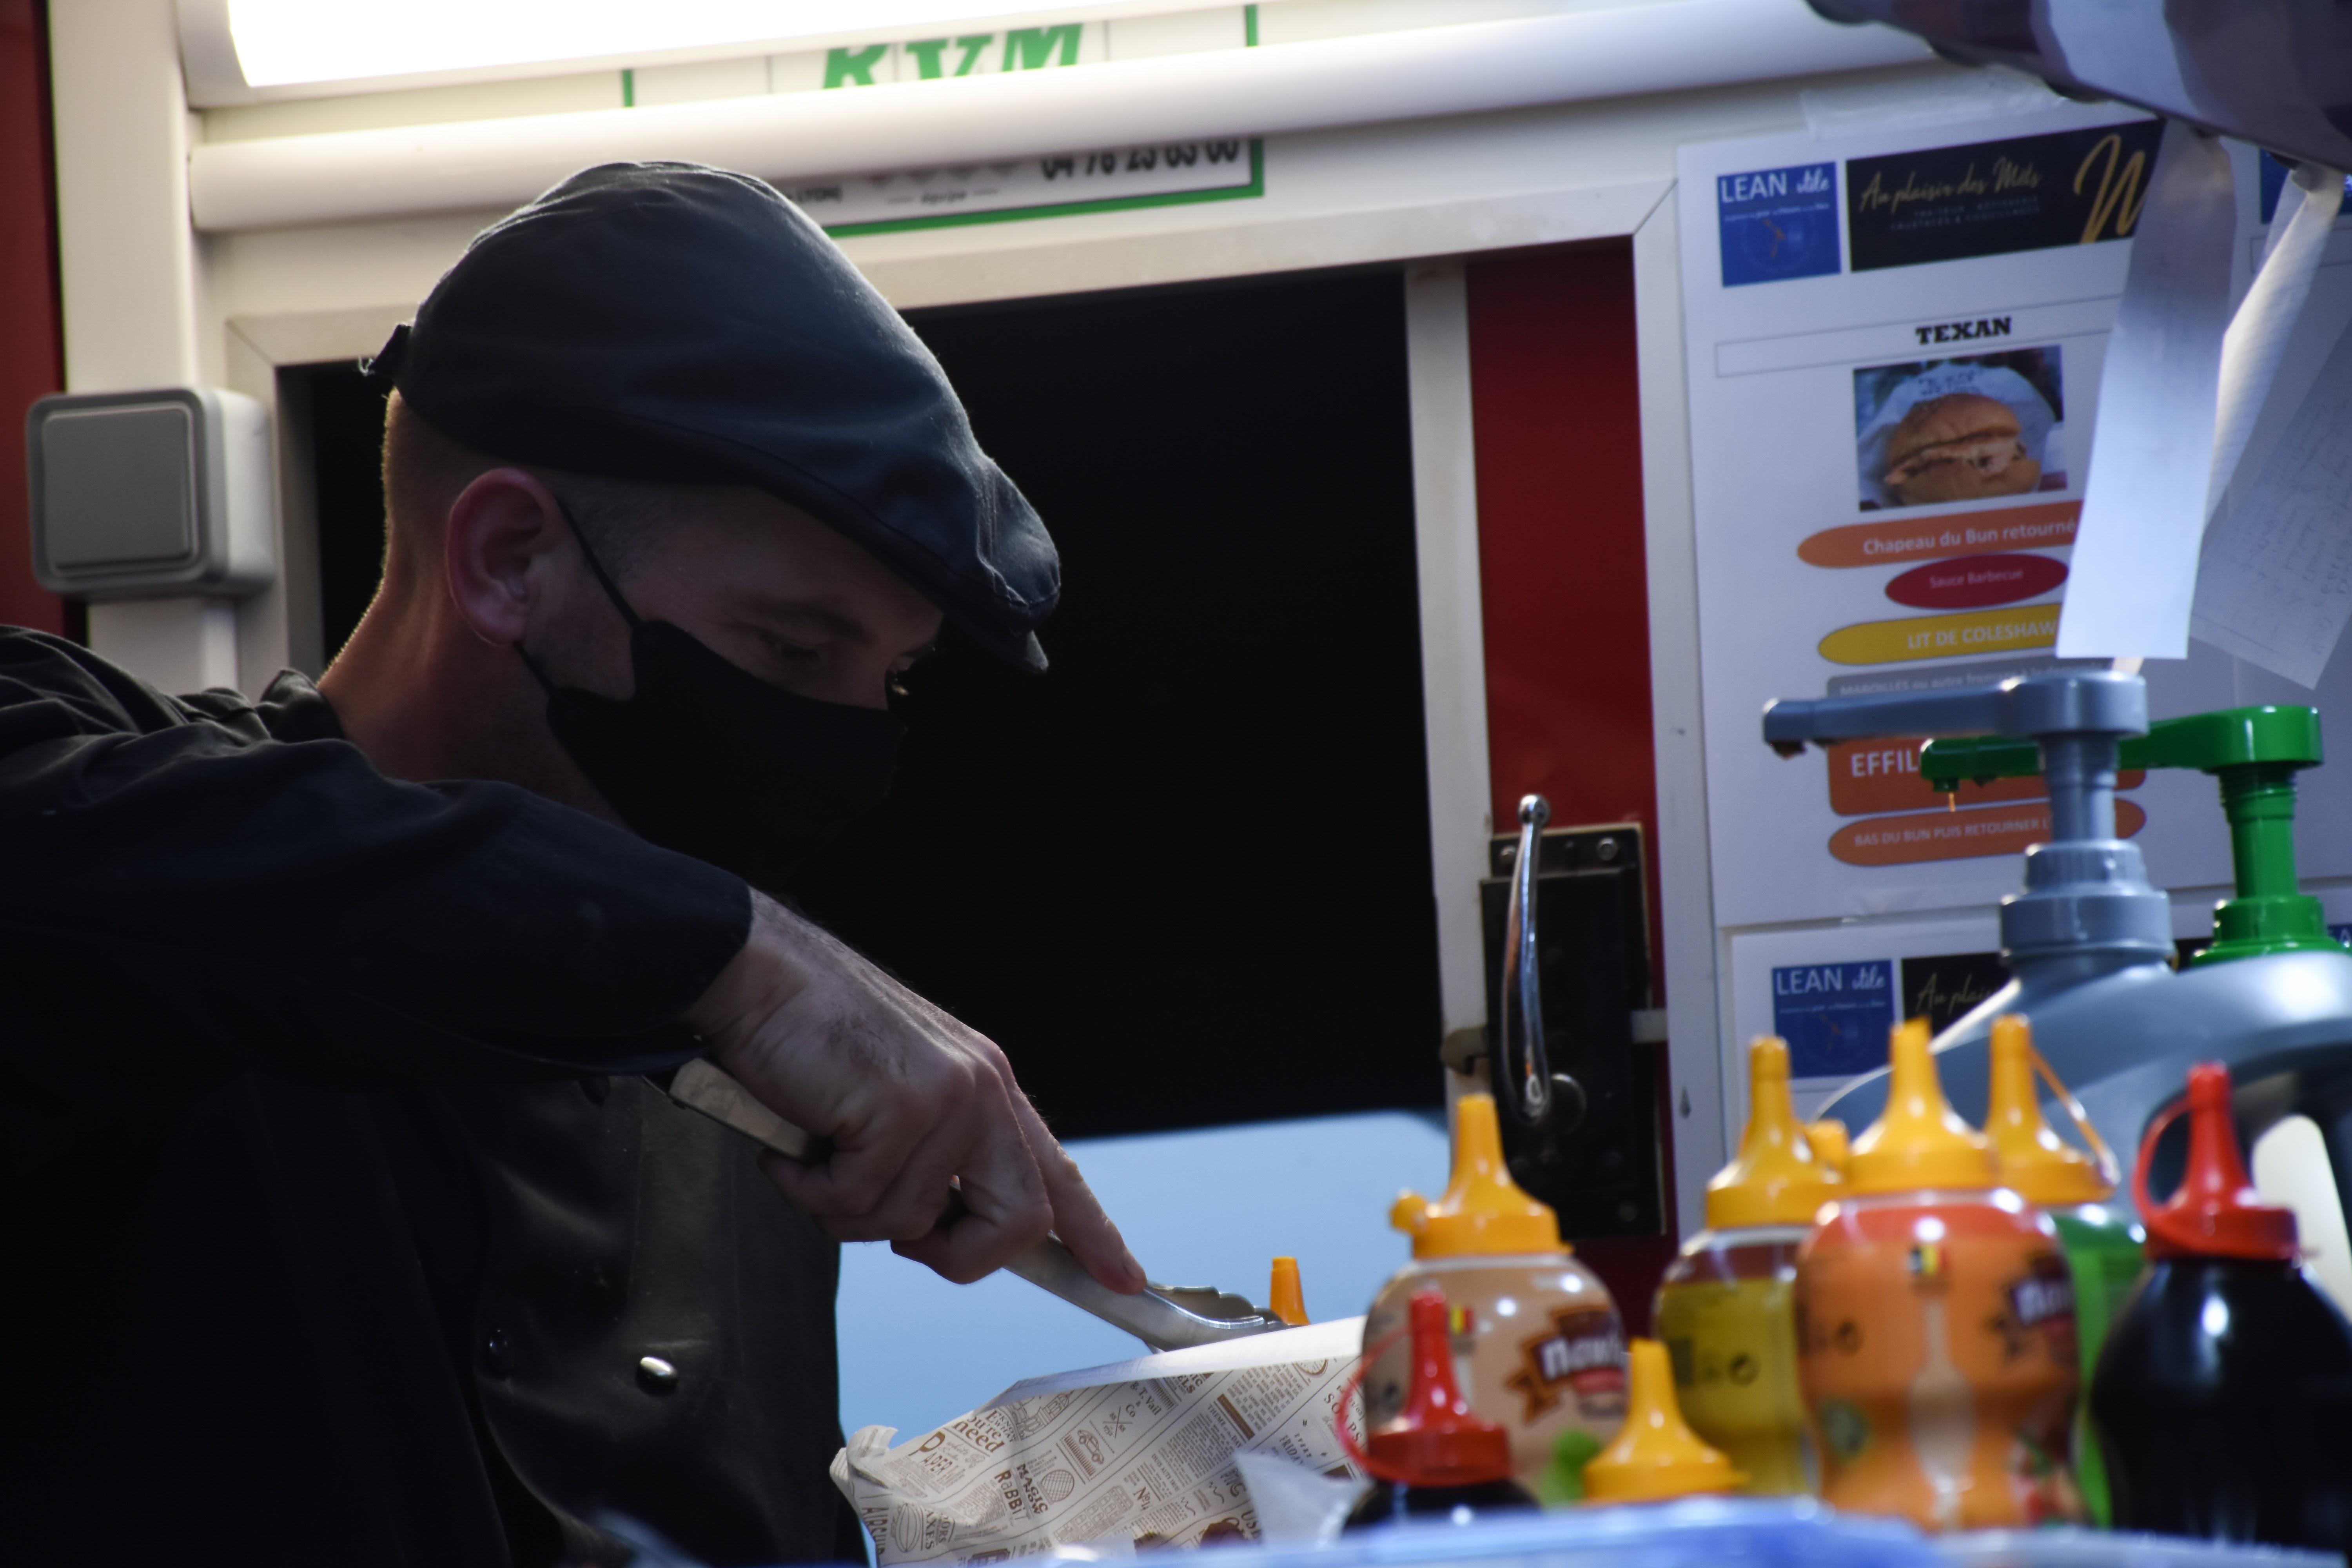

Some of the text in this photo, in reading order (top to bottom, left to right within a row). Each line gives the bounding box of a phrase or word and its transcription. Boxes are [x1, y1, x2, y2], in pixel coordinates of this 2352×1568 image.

[1720, 172, 1788, 204] LEAN
[1889, 171, 1957, 215] plaisir
[1957, 164, 1989, 196] des
[1916, 317, 2012, 345] TEXAN
[1864, 518, 2077, 556] Chapeau du Bun retourné
[1929, 566, 2024, 589] Sauce Barbecue
[1907, 631, 1933, 650] LIT
[1936, 630, 1957, 647] DE
[1855, 831, 1878, 847] BAS
[1880, 829, 1900, 844] DU
[1903, 827, 1931, 843] BUN
[1933, 824, 1962, 840] PUIS
[1965, 818, 2040, 838] RETOURNER
[1777, 967, 1843, 996] LEAN
[1125, 1403, 1136, 1418] Co
[1145, 1395, 1161, 1415] Vail
[951, 1421, 1004, 1453] need
[1208, 1404, 1226, 1426] THEME
[1232, 1435, 1241, 1448] DAY
[1017, 1463, 1048, 1513] MAGIC
[1024, 1483, 1041, 1514] NOW
